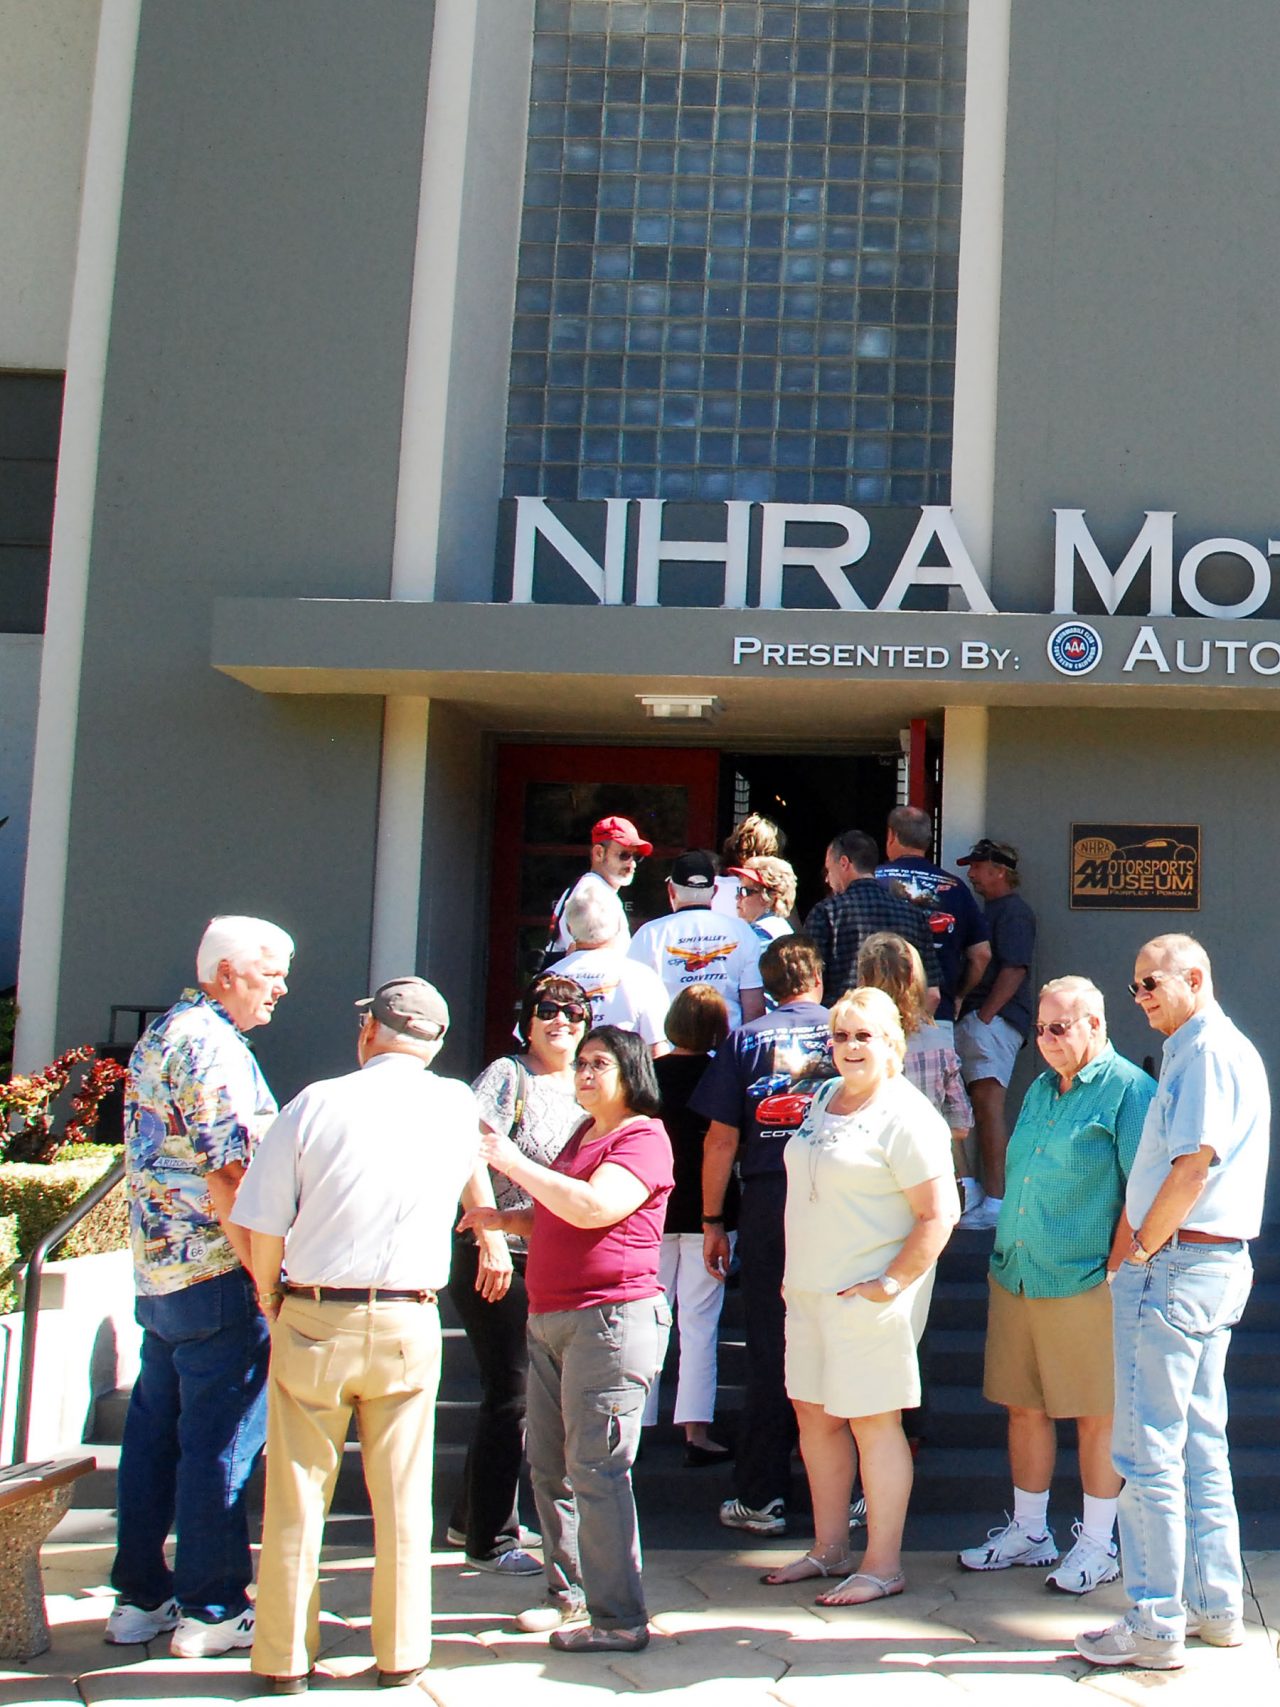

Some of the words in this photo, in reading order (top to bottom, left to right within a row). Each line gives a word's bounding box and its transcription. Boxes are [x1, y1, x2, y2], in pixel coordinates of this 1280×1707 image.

[510, 495, 999, 614] NHRA
[1064, 641, 1086, 653] AAA
[1080, 841, 1111, 855] NHRA
[191, 1248, 203, 1257] 66
